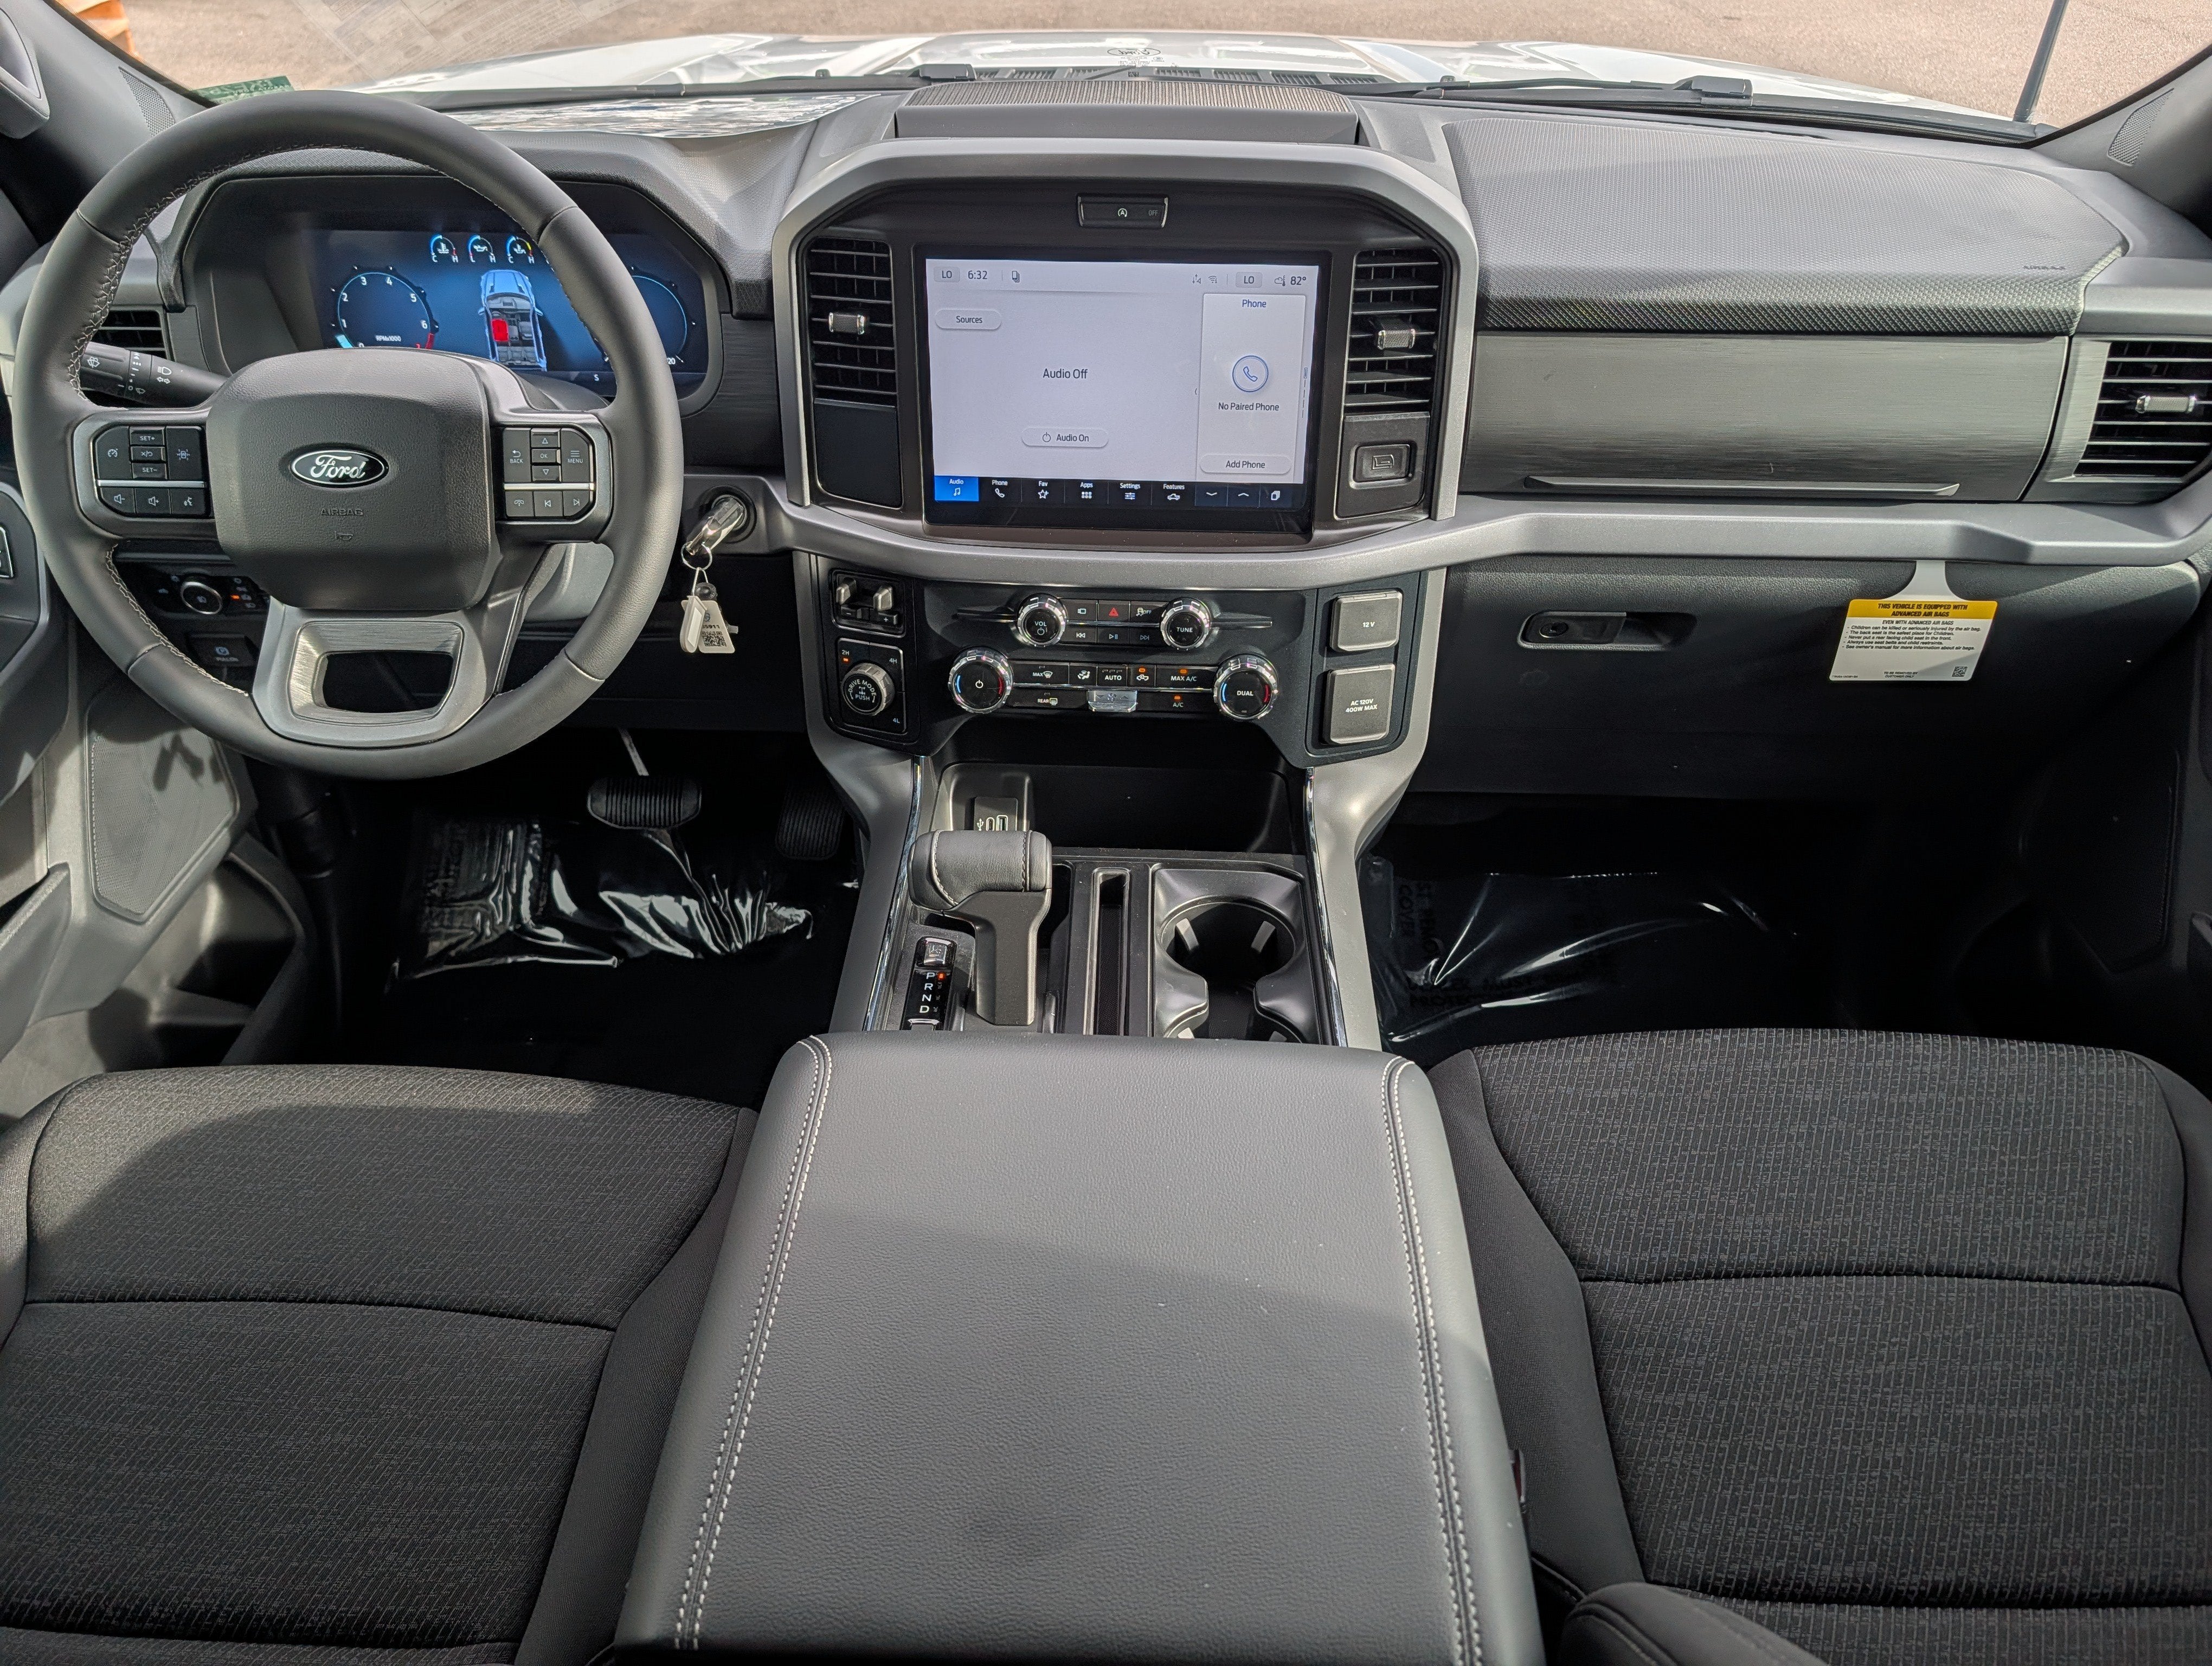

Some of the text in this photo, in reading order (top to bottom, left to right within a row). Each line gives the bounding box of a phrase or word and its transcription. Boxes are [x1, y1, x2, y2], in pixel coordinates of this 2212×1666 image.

[490, 255, 496, 263] H
[941, 270, 953, 279] LO
[968, 270, 988, 280] 6:32
[360, 277, 367, 285] 3
[386, 277, 393, 285] 4
[1244, 275, 1255, 284] LO
[1290, 276, 1307, 286] 82°
[342, 292, 349, 302] 2
[410, 293, 417, 303] 5
[1242, 299, 1266, 309] Phone
[341, 318, 347, 328] 1
[421, 319, 428, 329] 6
[956, 315, 983, 324] Sources
[594, 374, 599, 382] S
[1043, 368, 1088, 379] Audio Off
[1218, 402, 1279, 411] No Paired Phone
[1056, 433, 1090, 442] Audio On
[310, 454, 366, 479] Ford
[1225, 460, 1265, 469] Add Phone
[320, 508, 364, 516] AIRBAG
[848, 679, 877, 696] DRIVE MODE
[919, 1005, 930, 1013] D
